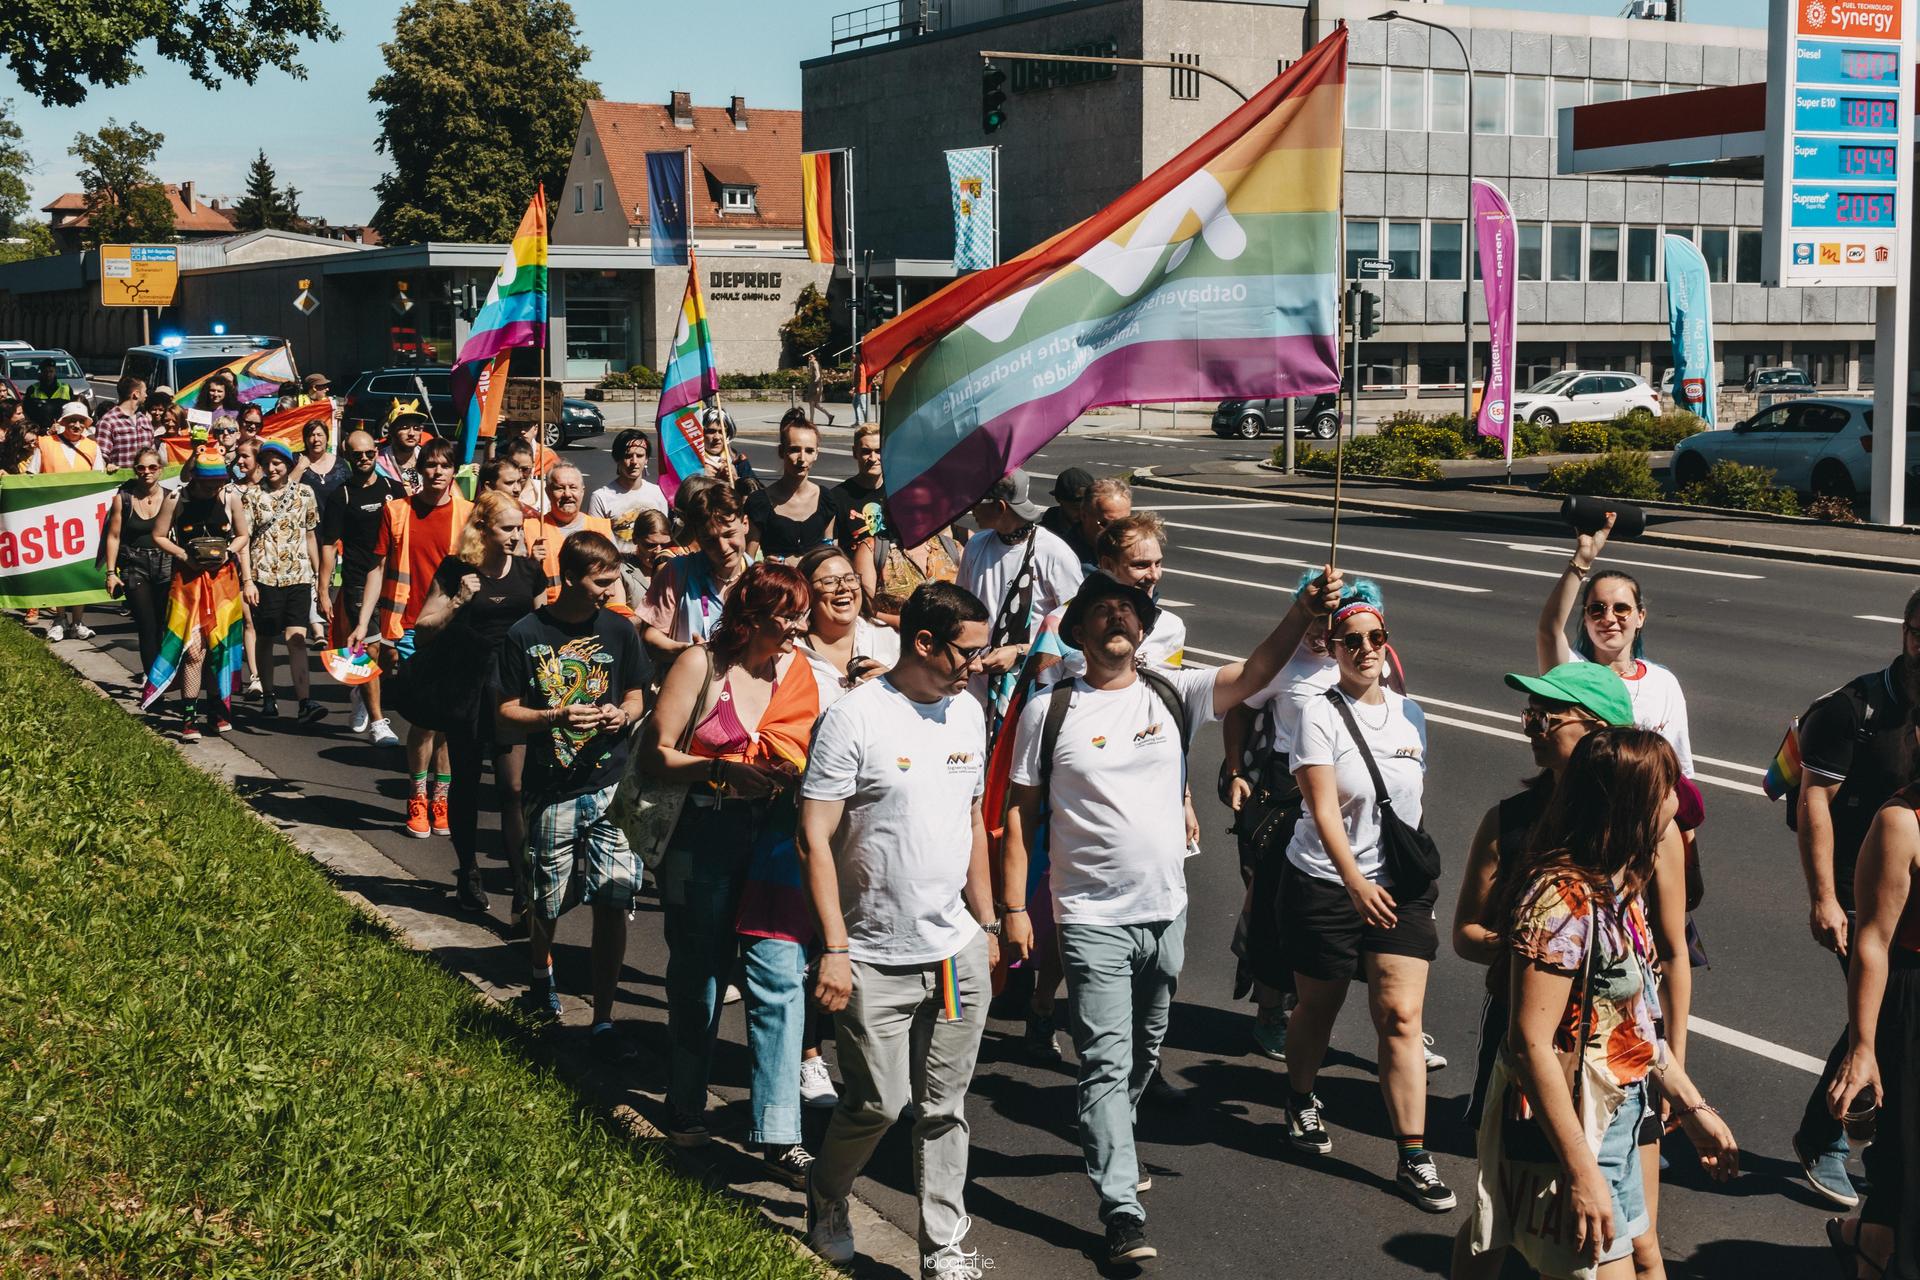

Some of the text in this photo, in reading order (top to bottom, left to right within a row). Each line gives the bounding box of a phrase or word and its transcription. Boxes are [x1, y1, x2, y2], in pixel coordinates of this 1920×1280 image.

[1857, 3, 1893, 11] TECHNOLOGY
[1831, 5, 1893, 32] Synergy
[1797, 48, 1821, 59] Diesel
[1797, 97, 1819, 109] Super
[1821, 98, 1836, 108] E10
[1794, 145, 1818, 157] Super
[1848, 250, 1863, 258] DKV
[1874, 246, 1889, 262] UTA
[710, 272, 782, 288] DEPRAG
[710, 292, 740, 301] SCHULZ
[1695, 318, 1704, 370] Esso Pay
[479, 370, 490, 393] DIE
[1492, 406, 1504, 416] Ess
[681, 419, 703, 439] DIE
